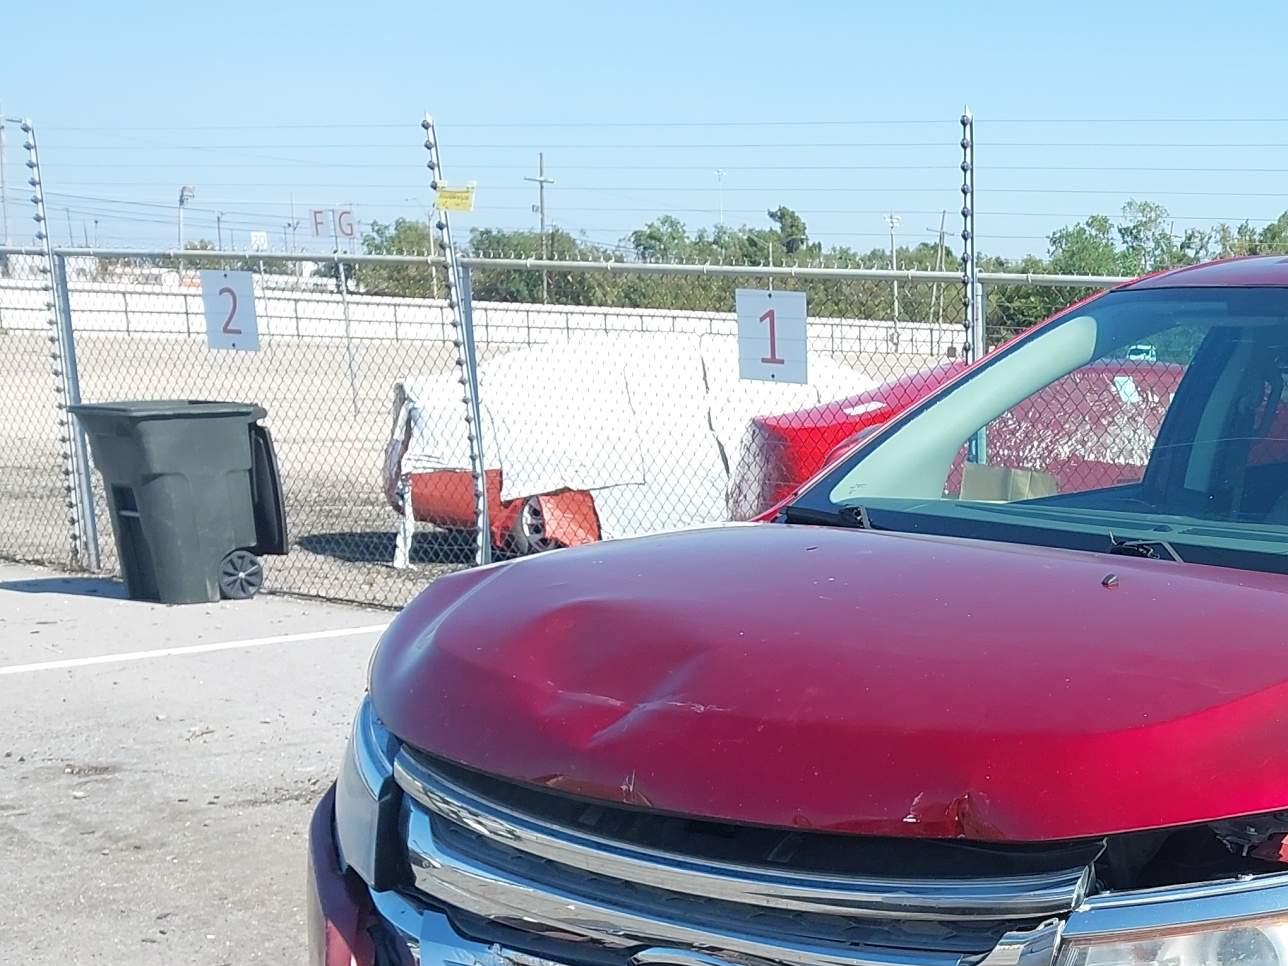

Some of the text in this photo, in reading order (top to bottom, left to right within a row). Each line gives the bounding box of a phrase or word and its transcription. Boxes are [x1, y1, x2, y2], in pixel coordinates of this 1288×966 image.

[313, 210, 324, 237] F
[338, 210, 354, 236] G
[218, 287, 242, 335] 2
[759, 309, 785, 365] 1
